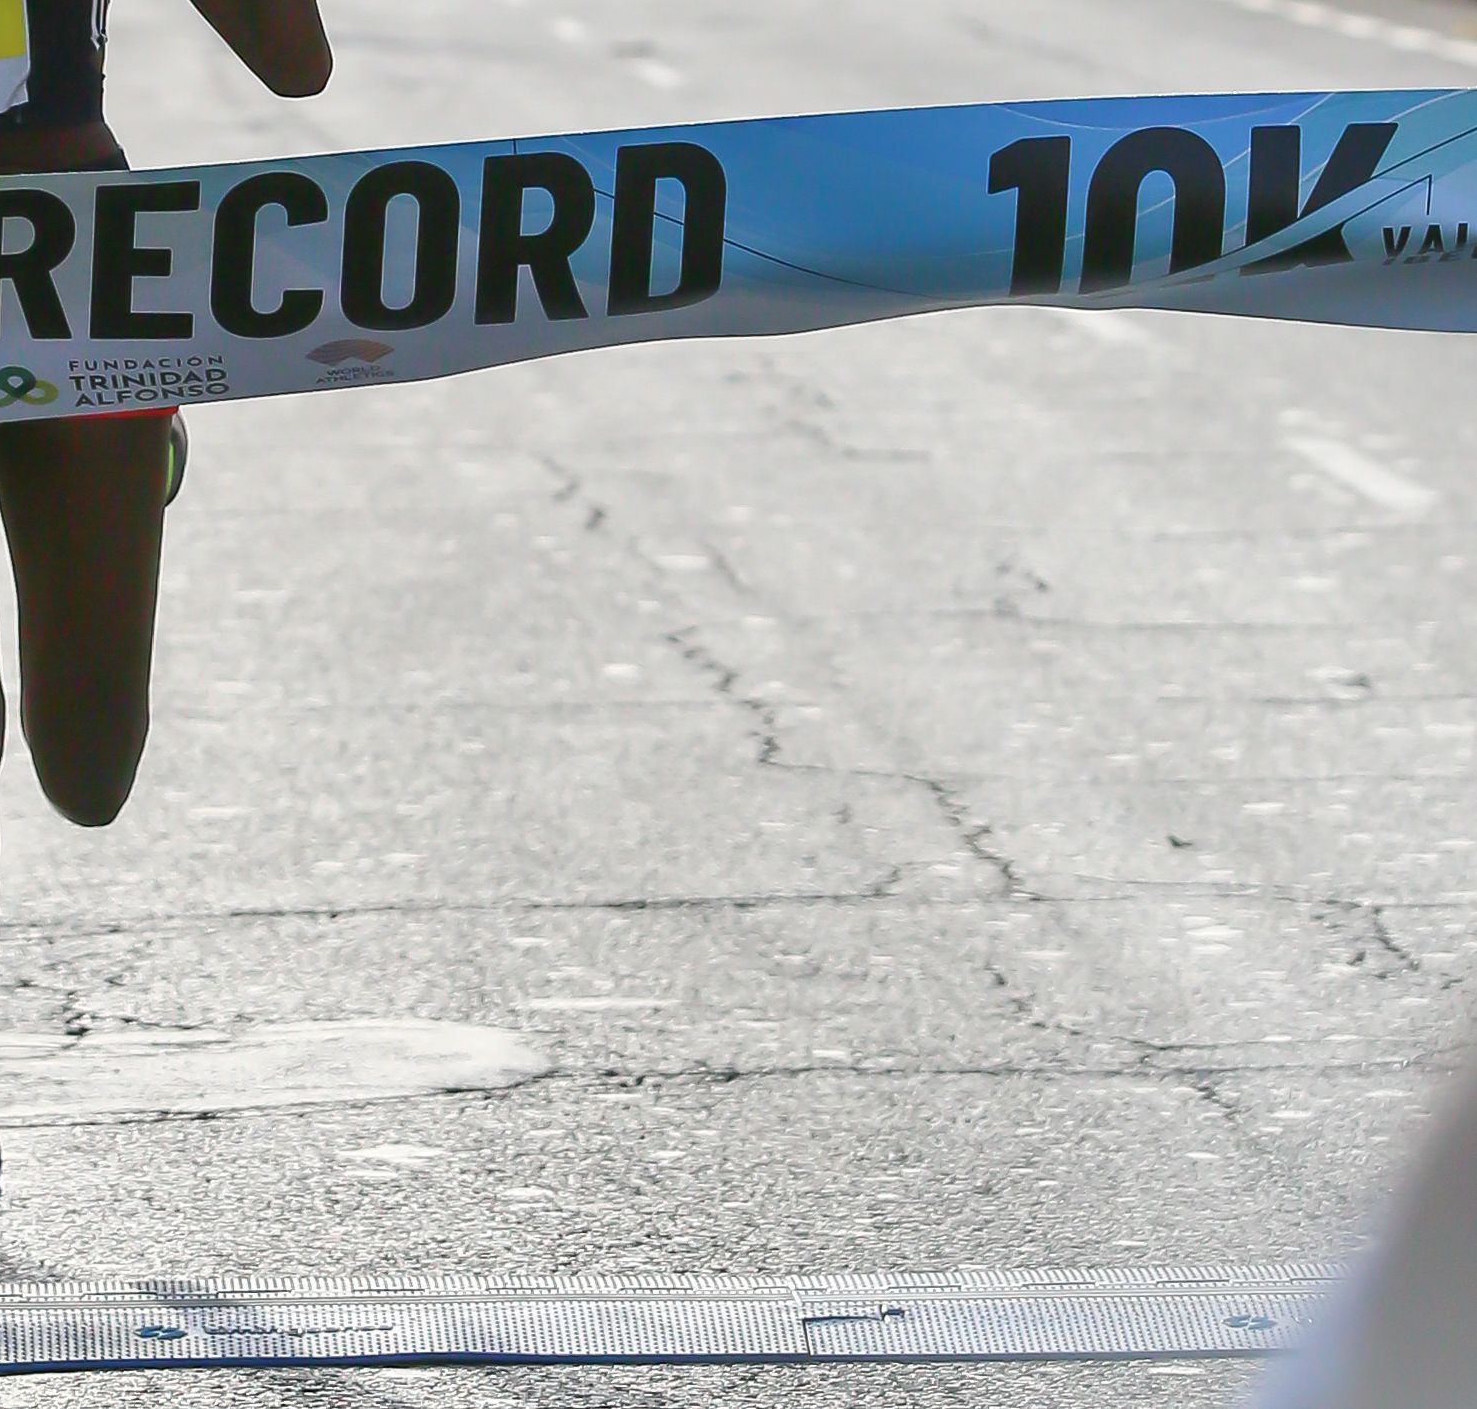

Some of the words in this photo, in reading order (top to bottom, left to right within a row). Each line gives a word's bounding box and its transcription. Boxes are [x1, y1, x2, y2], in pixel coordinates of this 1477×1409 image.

[988, 123, 1399, 295] 10K
[69, 369, 227, 392] TRINIDAD
[75, 382, 230, 407] ALFONSO
